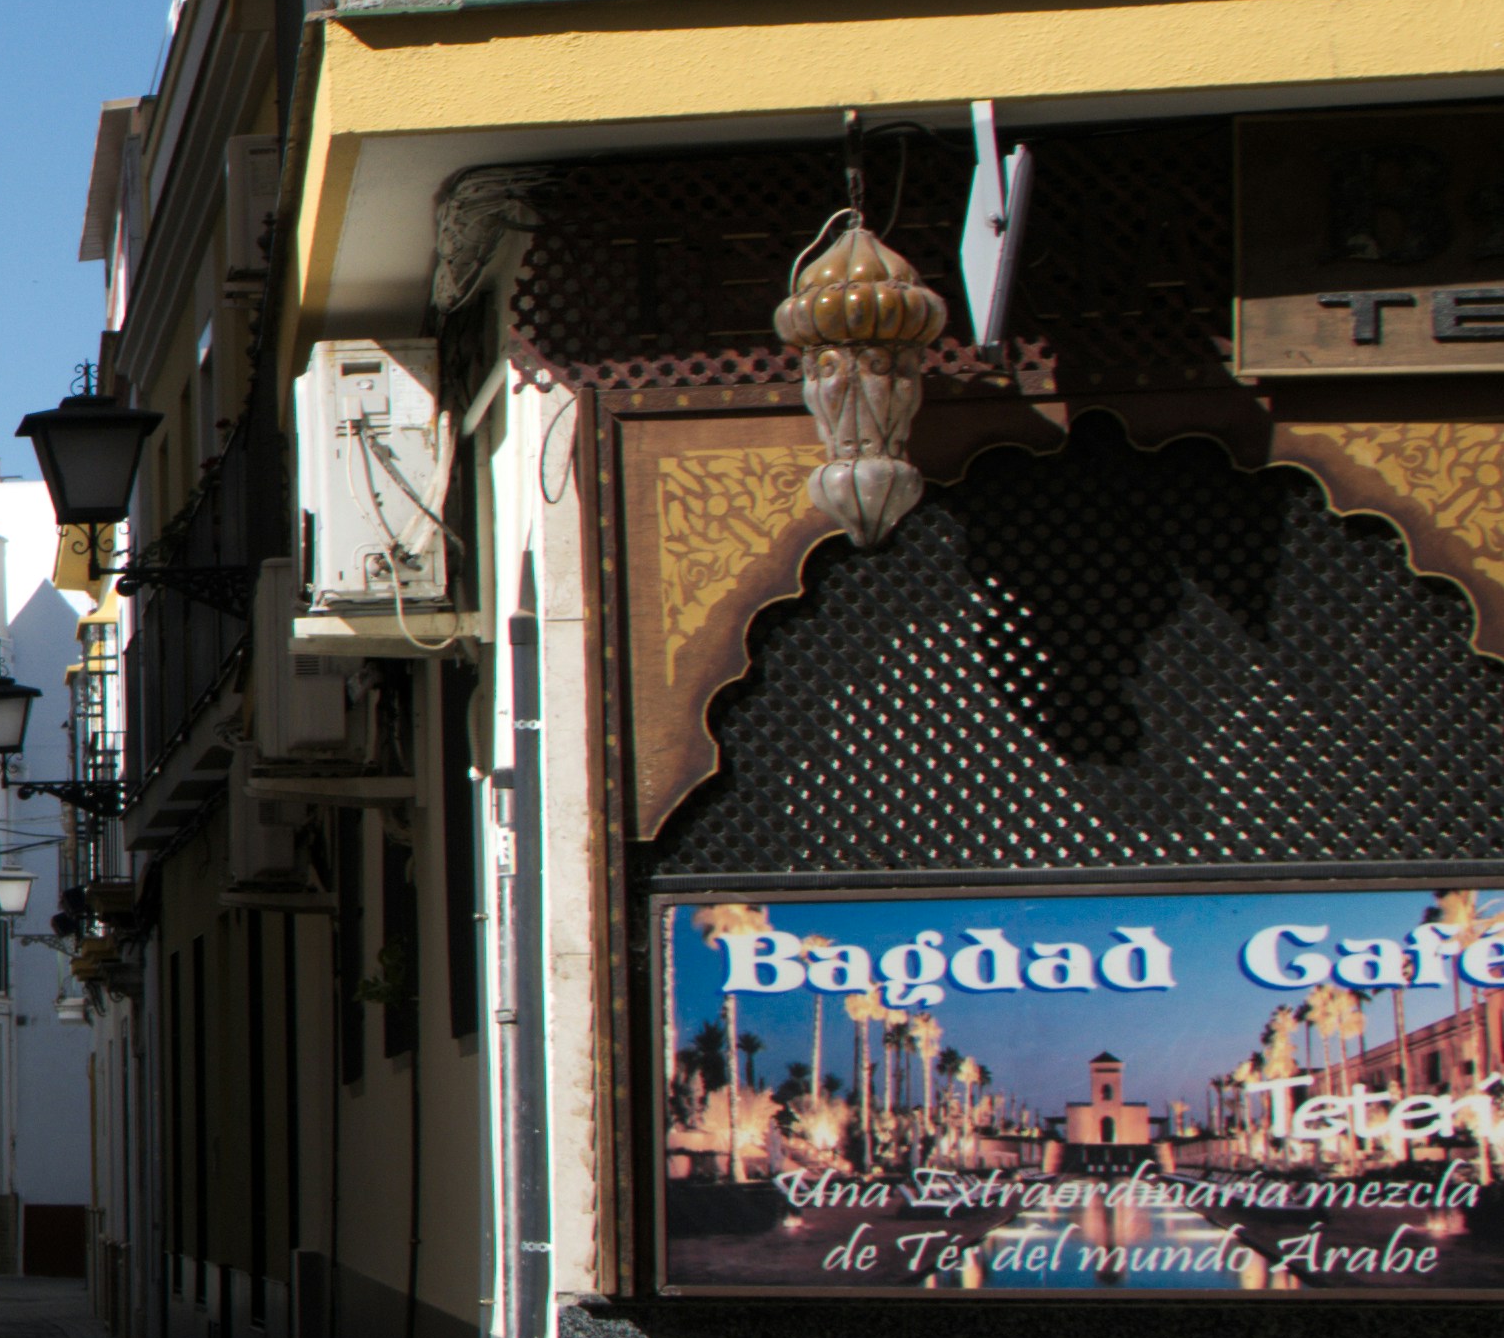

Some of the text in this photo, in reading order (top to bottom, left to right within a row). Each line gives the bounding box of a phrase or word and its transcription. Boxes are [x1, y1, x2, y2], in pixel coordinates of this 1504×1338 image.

[720, 926, 1176, 1009] Bagdad
[1245, 1068, 1504, 1145] Teterí
[773, 1167, 891, 1208] Una
[1303, 1158, 1480, 1208] mezcla
[822, 1221, 1439, 1273] de Tés del mundo Árabe
